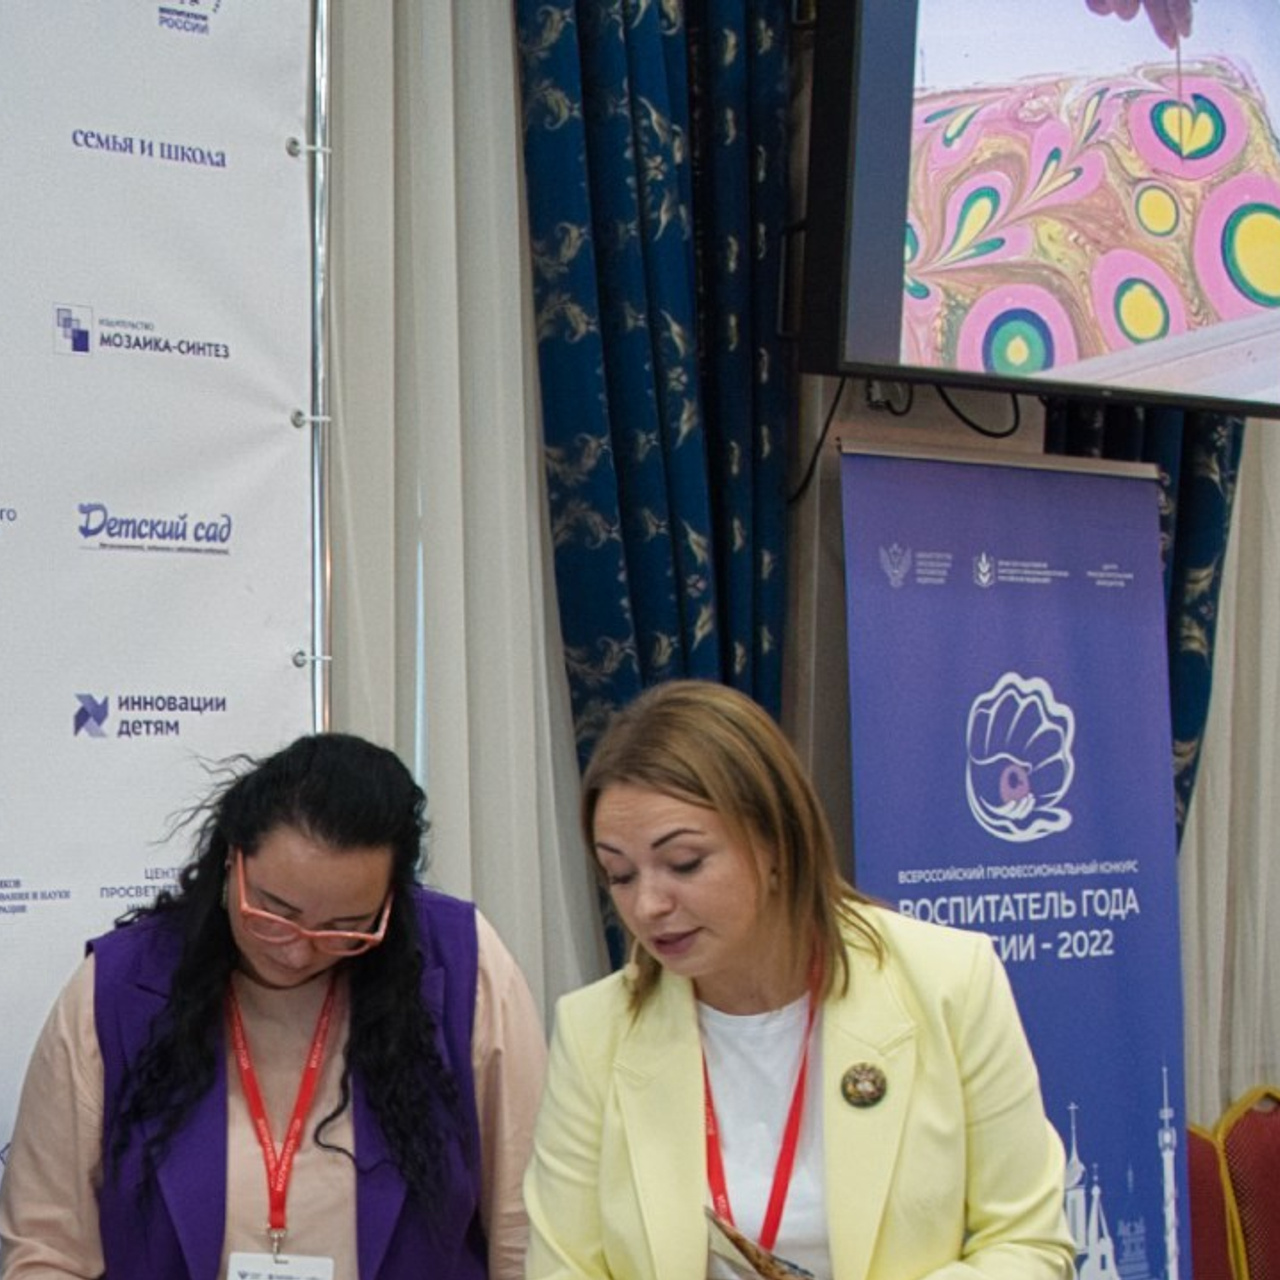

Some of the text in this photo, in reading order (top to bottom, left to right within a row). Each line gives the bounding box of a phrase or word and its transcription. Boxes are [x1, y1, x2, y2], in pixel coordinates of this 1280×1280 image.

[158, 17, 209, 35] РОССИИ
[99, 332, 230, 358] МОЗАИКА-СИНТЕЗ
[78, 503, 233, 543] Детский сад
[898, 859, 1139, 885] ВСЕРОССИЙСКИЙ ПРОФЕССИОНАЛЬНЫЙ КОНКУРС
[899, 887, 1141, 925] ВОСПИТАТЕЛЬ ГОДА
[1057, 929, 1114, 960] 2022
